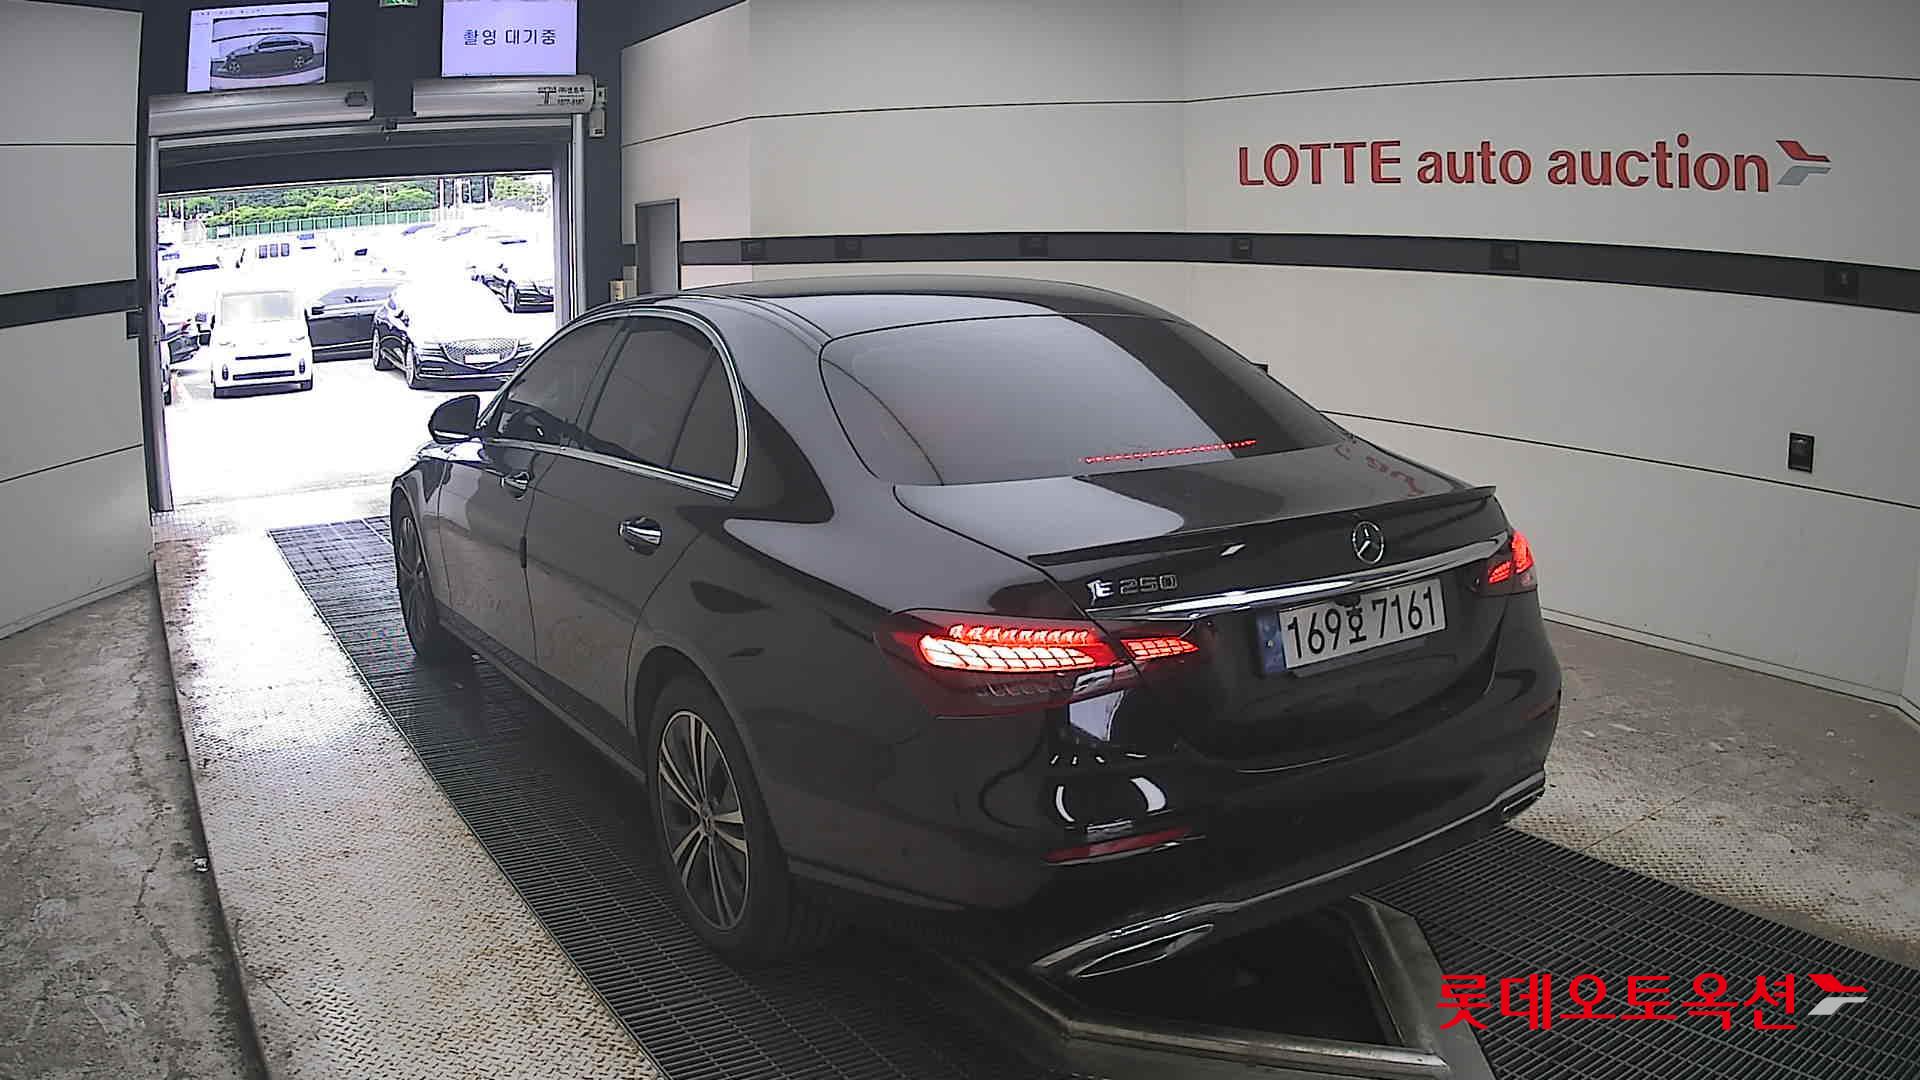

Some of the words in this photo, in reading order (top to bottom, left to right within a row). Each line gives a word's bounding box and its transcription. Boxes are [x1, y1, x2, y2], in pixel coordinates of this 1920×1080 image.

[505, 29, 556, 46] 대기중
[1239, 141, 1401, 186] LOTTE
[1417, 141, 1532, 185] auto
[1549, 133, 1770, 192] auction
[1089, 579, 1114, 599] E
[1119, 574, 1178, 595] 250
[1372, 586, 1436, 638] 7161
